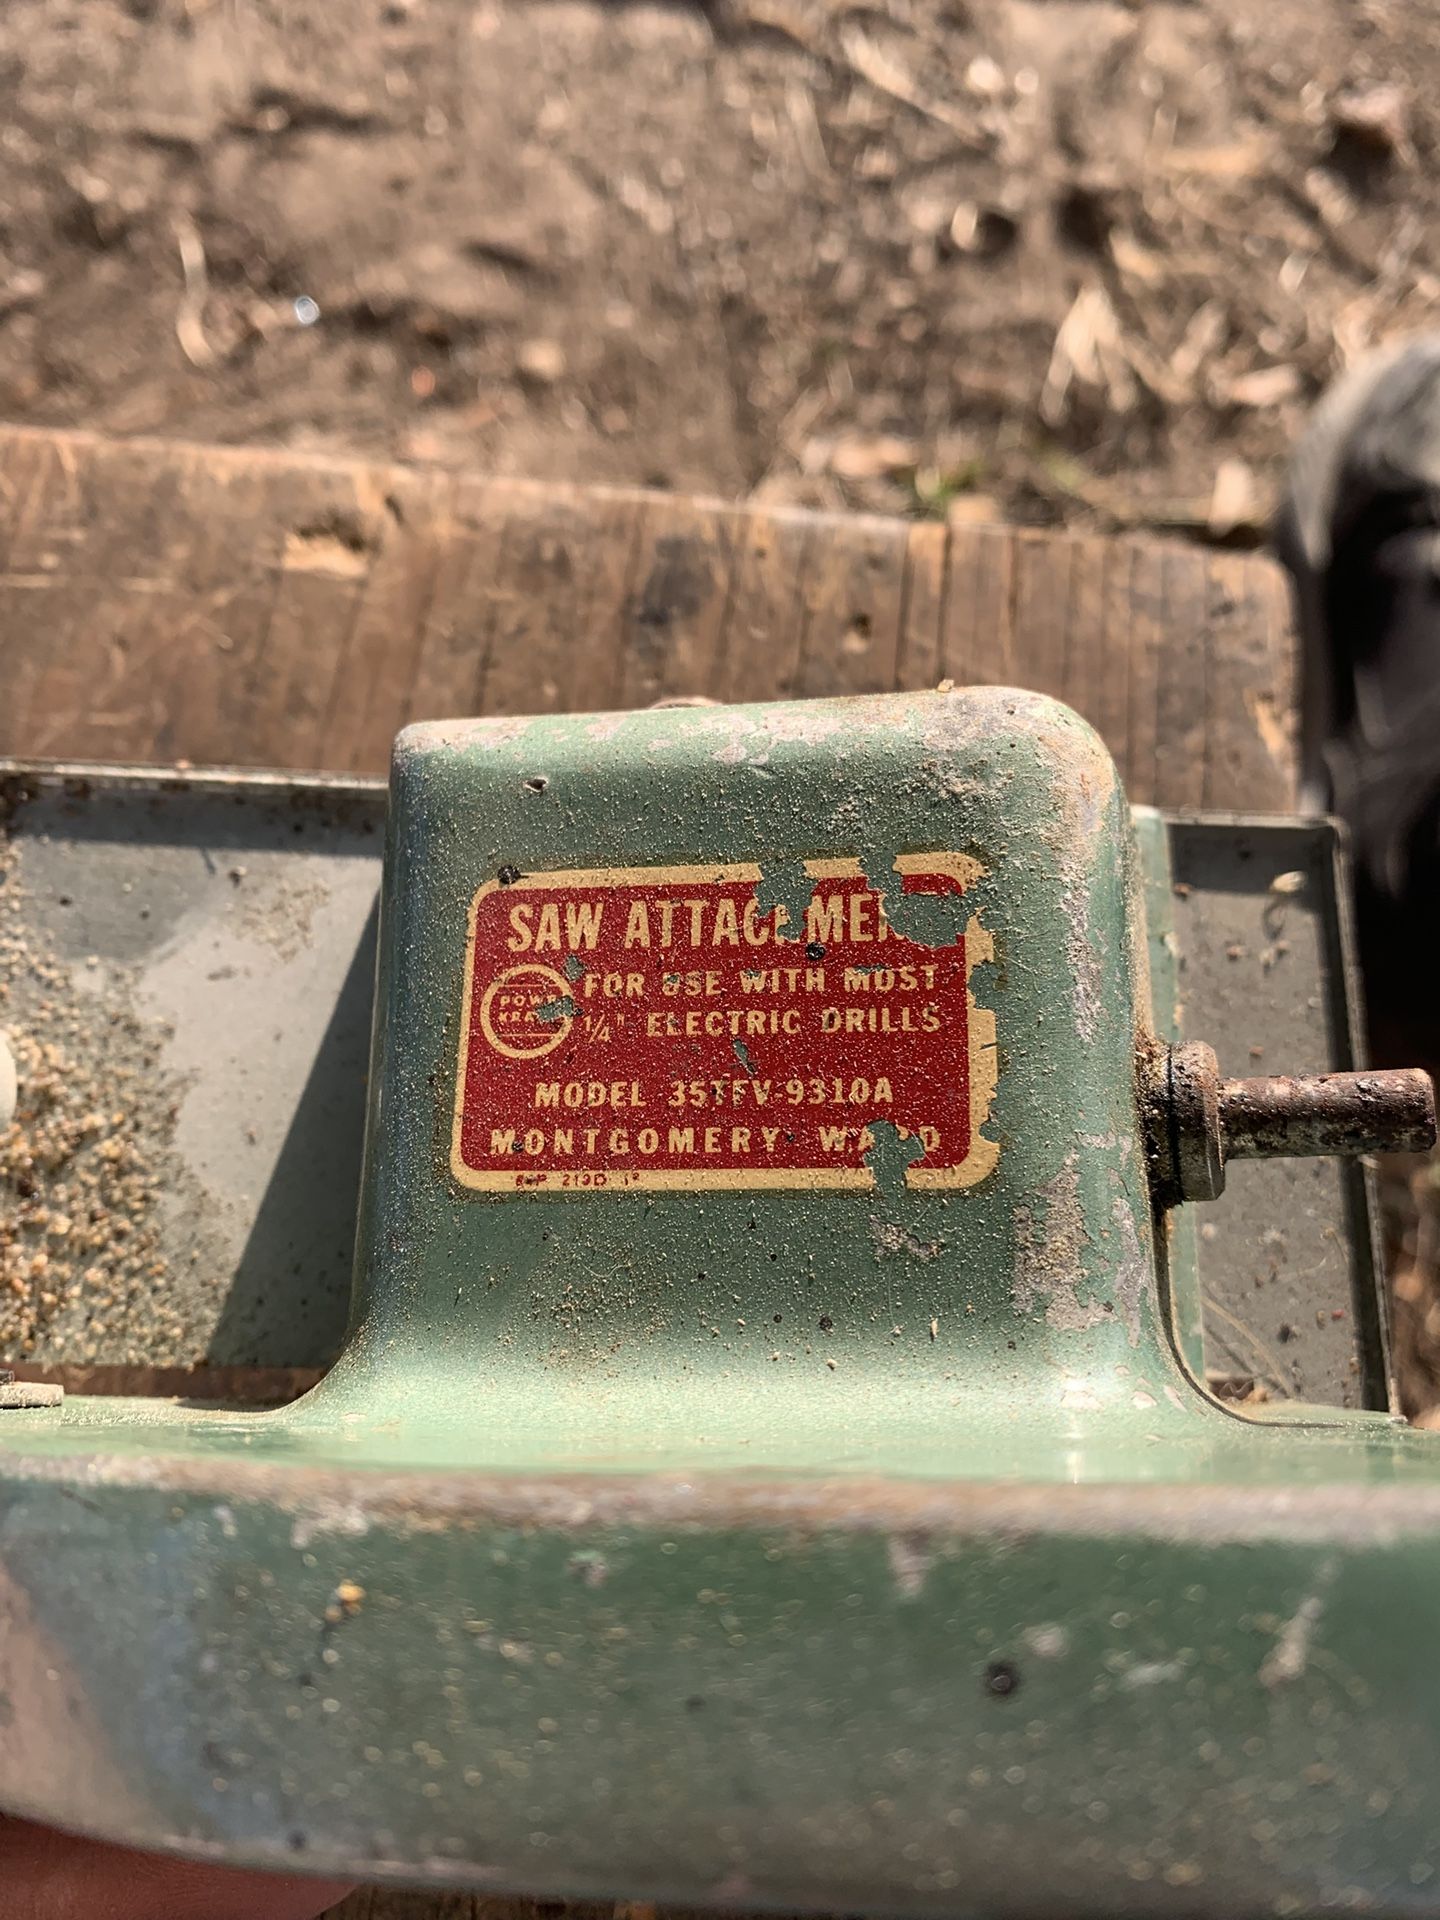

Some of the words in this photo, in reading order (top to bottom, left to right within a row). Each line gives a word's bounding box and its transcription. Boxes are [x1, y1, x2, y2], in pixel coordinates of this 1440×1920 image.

[507, 901, 604, 952] SAW
[583, 972, 645, 999] FOR
[739, 966, 826, 994] WITH
[844, 964, 939, 992] MOST
[646, 1008, 802, 1038] ELECTRIC
[821, 1003, 942, 1035] DRILLS
[534, 1079, 648, 1108] MODEL
[489, 1124, 780, 1156] MONTGOMERY
